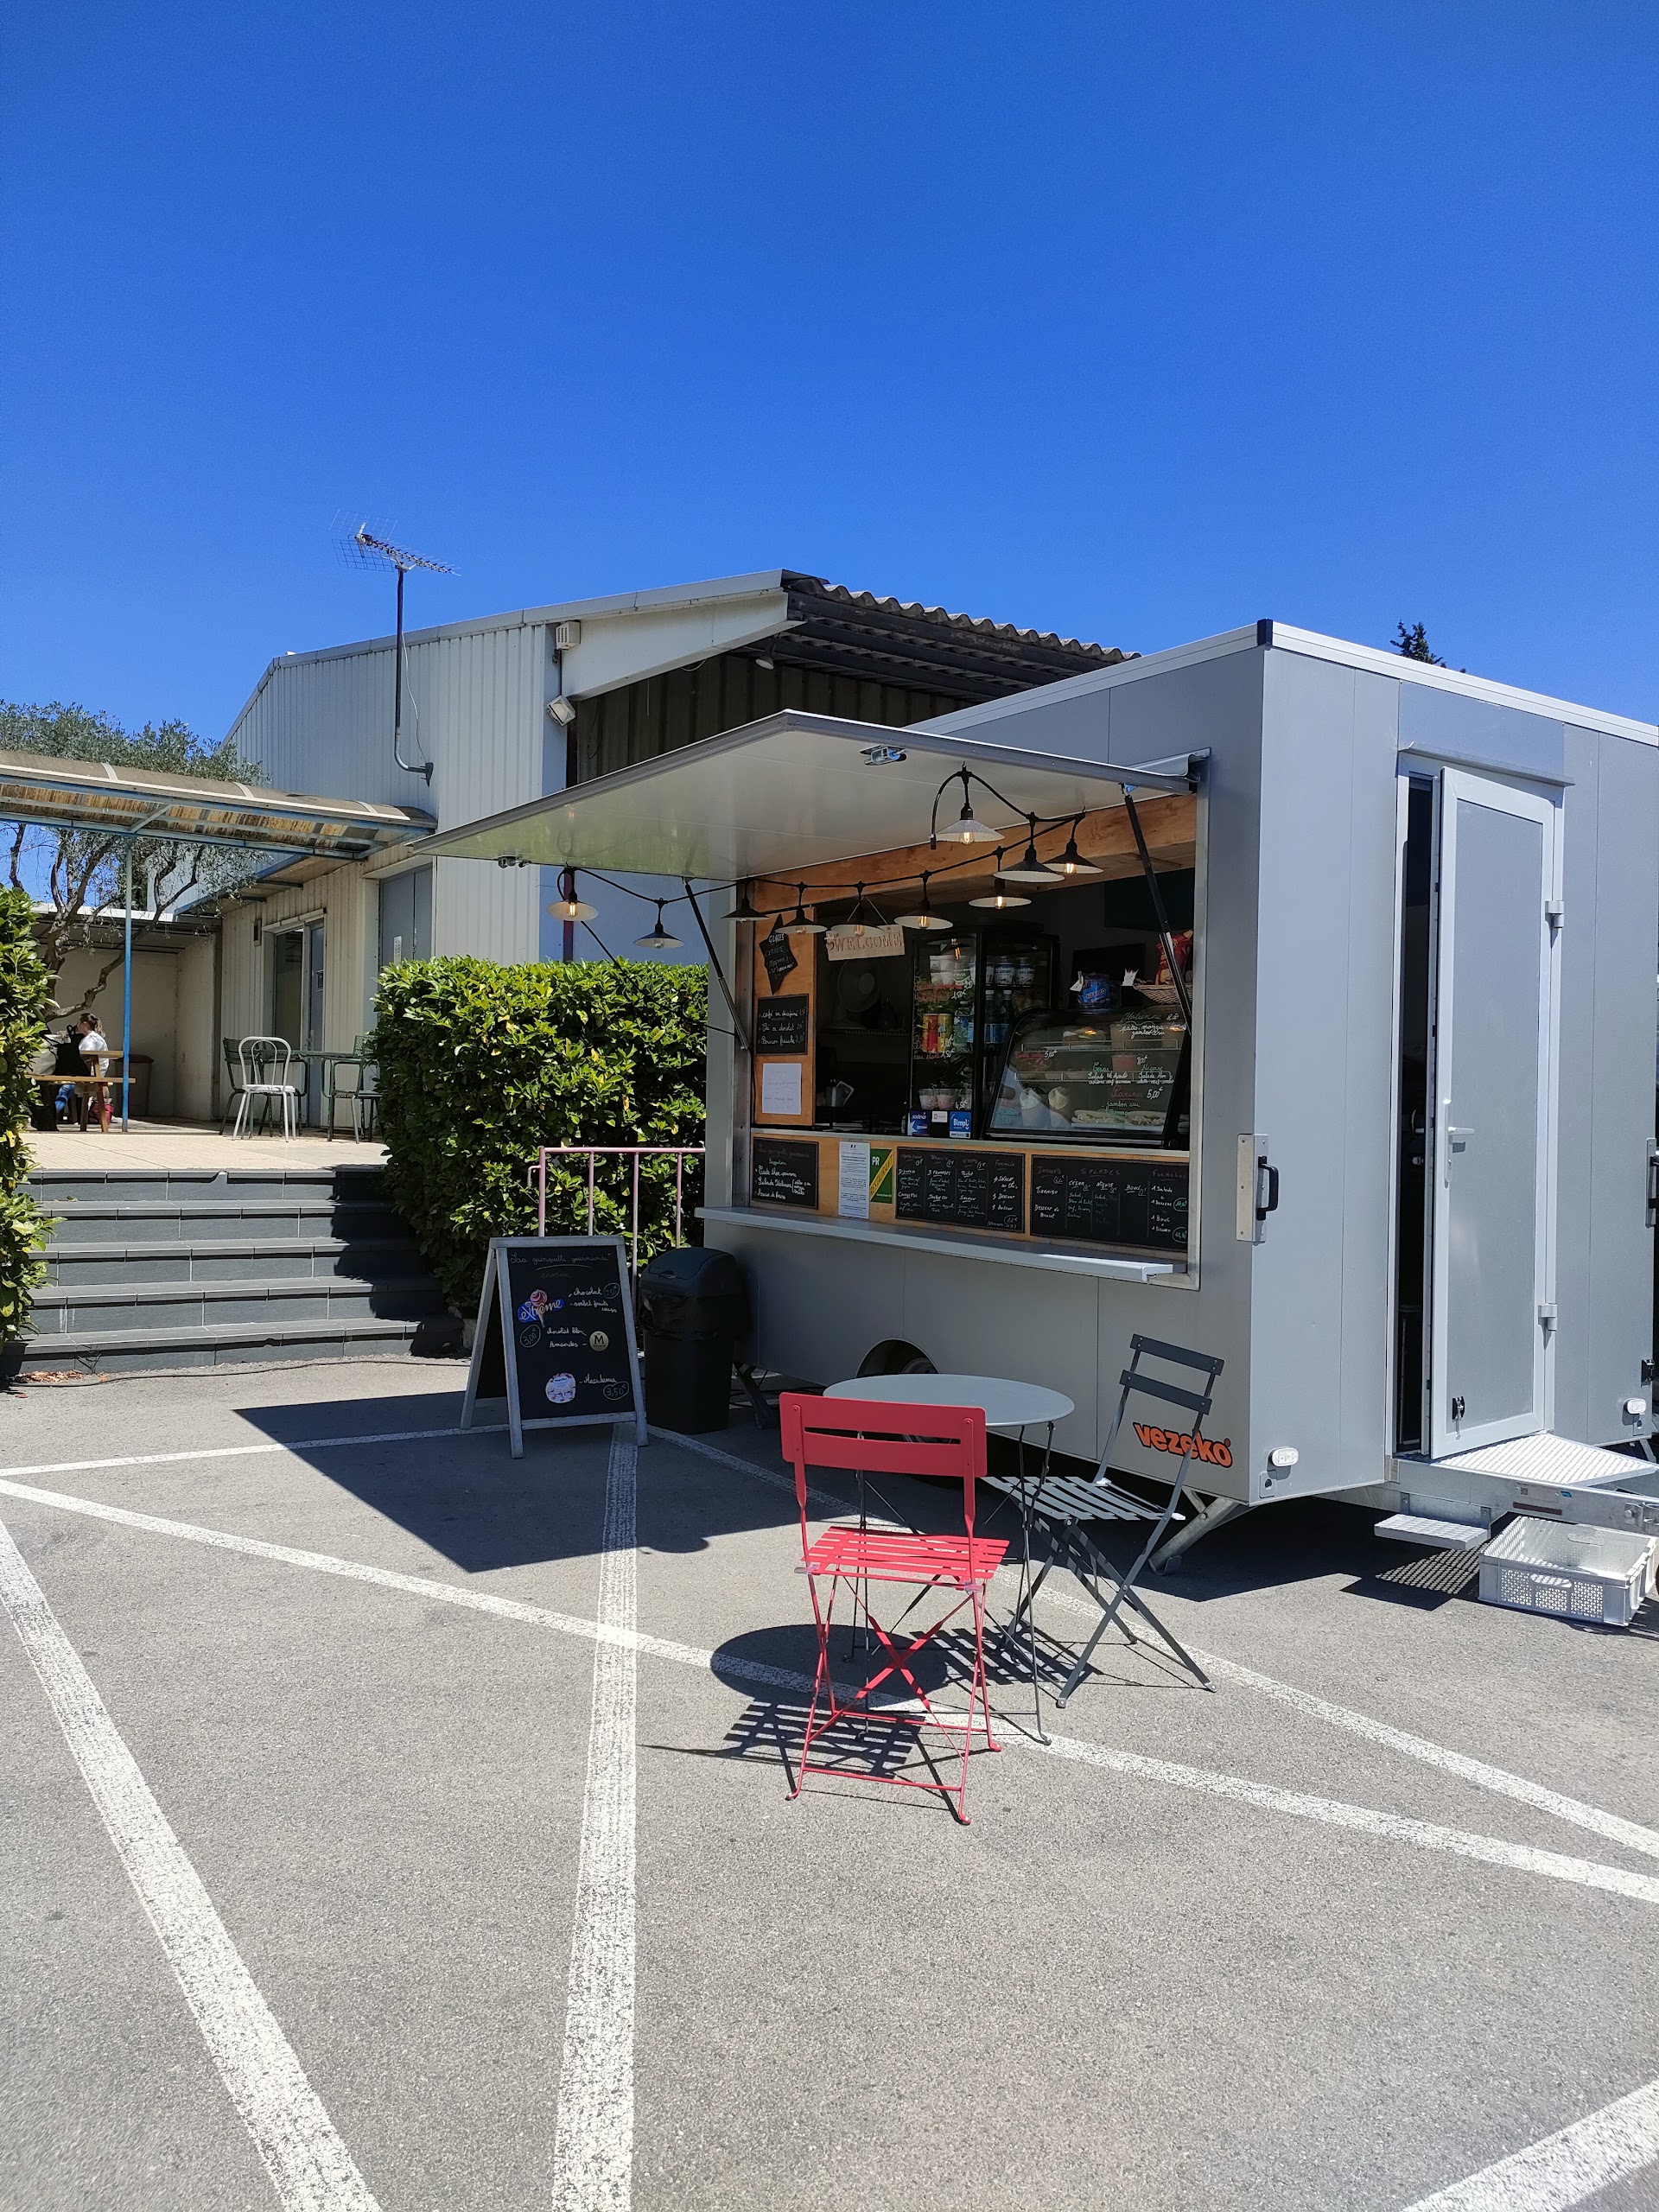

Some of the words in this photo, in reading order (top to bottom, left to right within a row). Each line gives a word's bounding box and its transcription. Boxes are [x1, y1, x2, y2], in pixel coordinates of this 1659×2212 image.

[835, 932, 902, 952] WELCOME
[573, 1286, 603, 1296] chocolat
[546, 1326, 570, 1335] chocolat
[1133, 1422, 1233, 1468] vezeko
